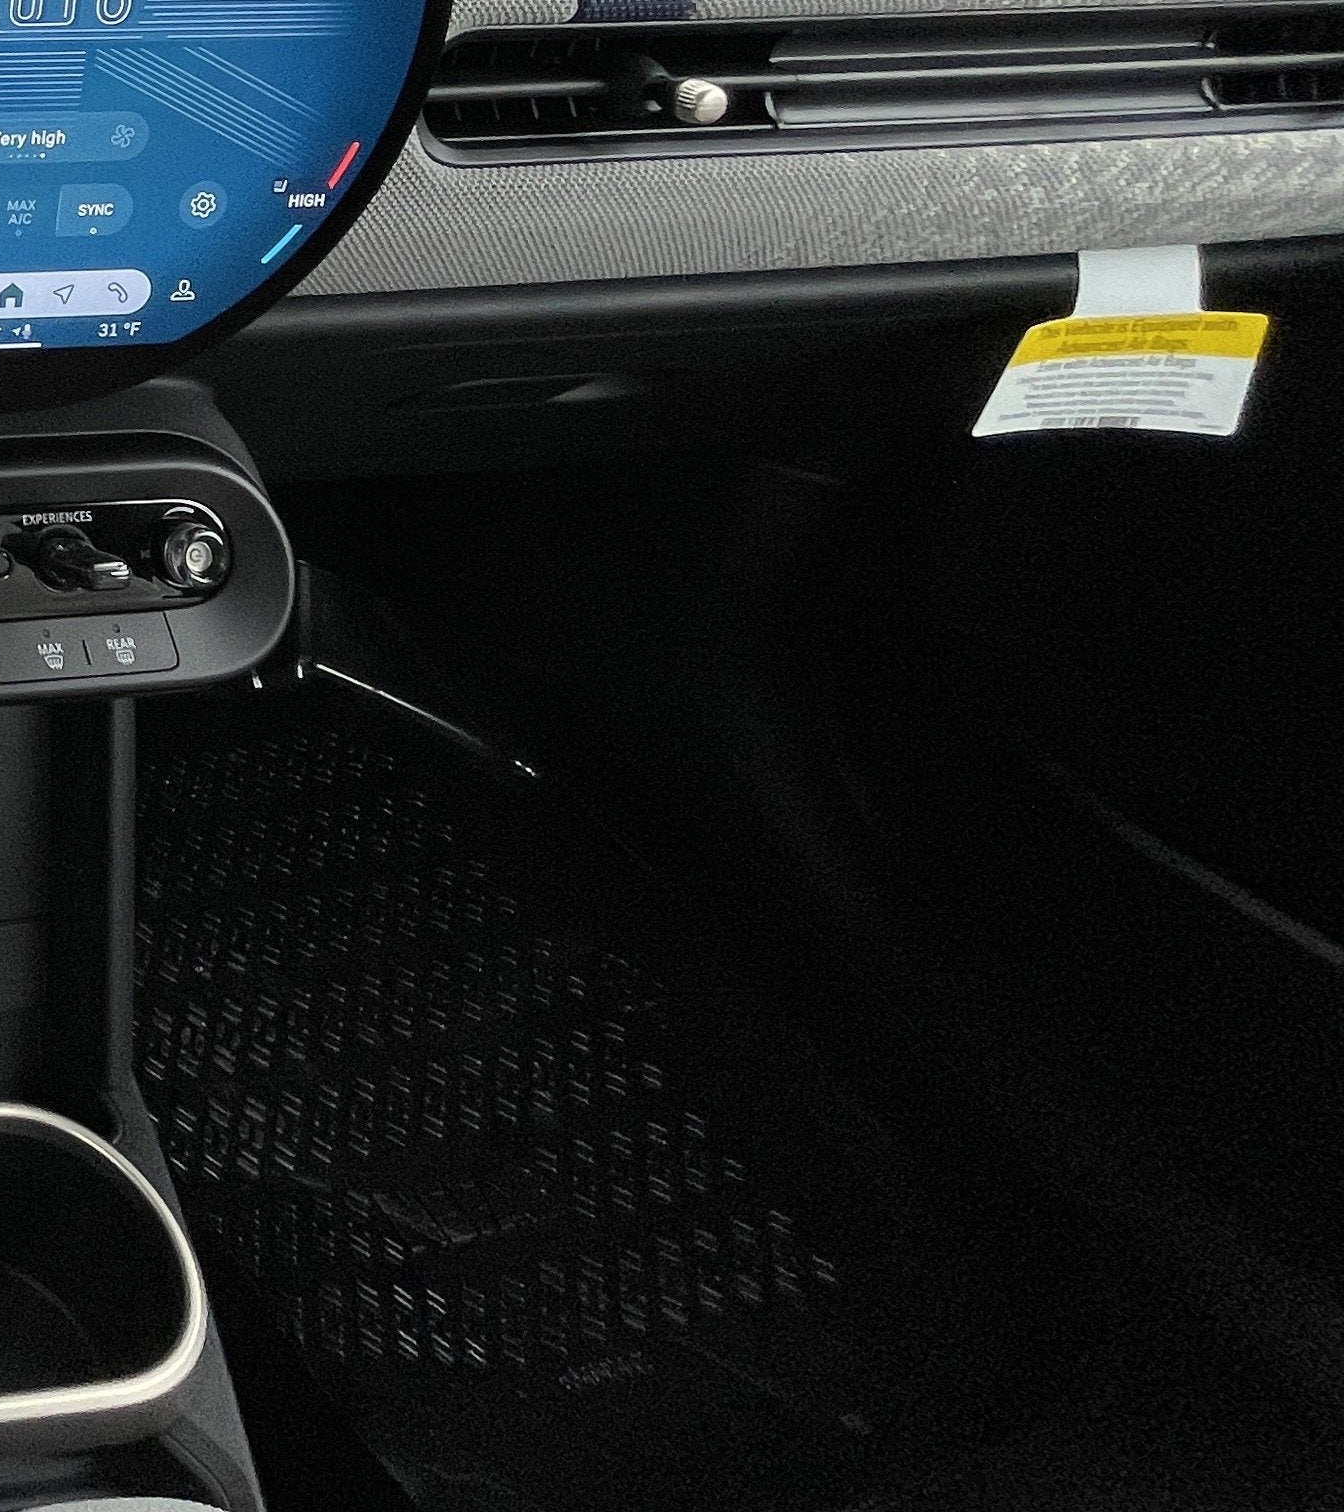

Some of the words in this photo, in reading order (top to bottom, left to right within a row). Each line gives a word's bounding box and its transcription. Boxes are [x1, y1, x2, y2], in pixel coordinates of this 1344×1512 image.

[30, 129, 66, 149] high
[7, 199, 37, 211] MAX
[288, 193, 326, 208] HIGH
[77, 203, 114, 217] SYNC
[8, 213, 33, 225] A/C
[98, 322, 118, 337] 31
[22, 511, 94, 526] EXPERIENCES
[37, 643, 64, 656] MAX
[105, 637, 137, 651] REAR
